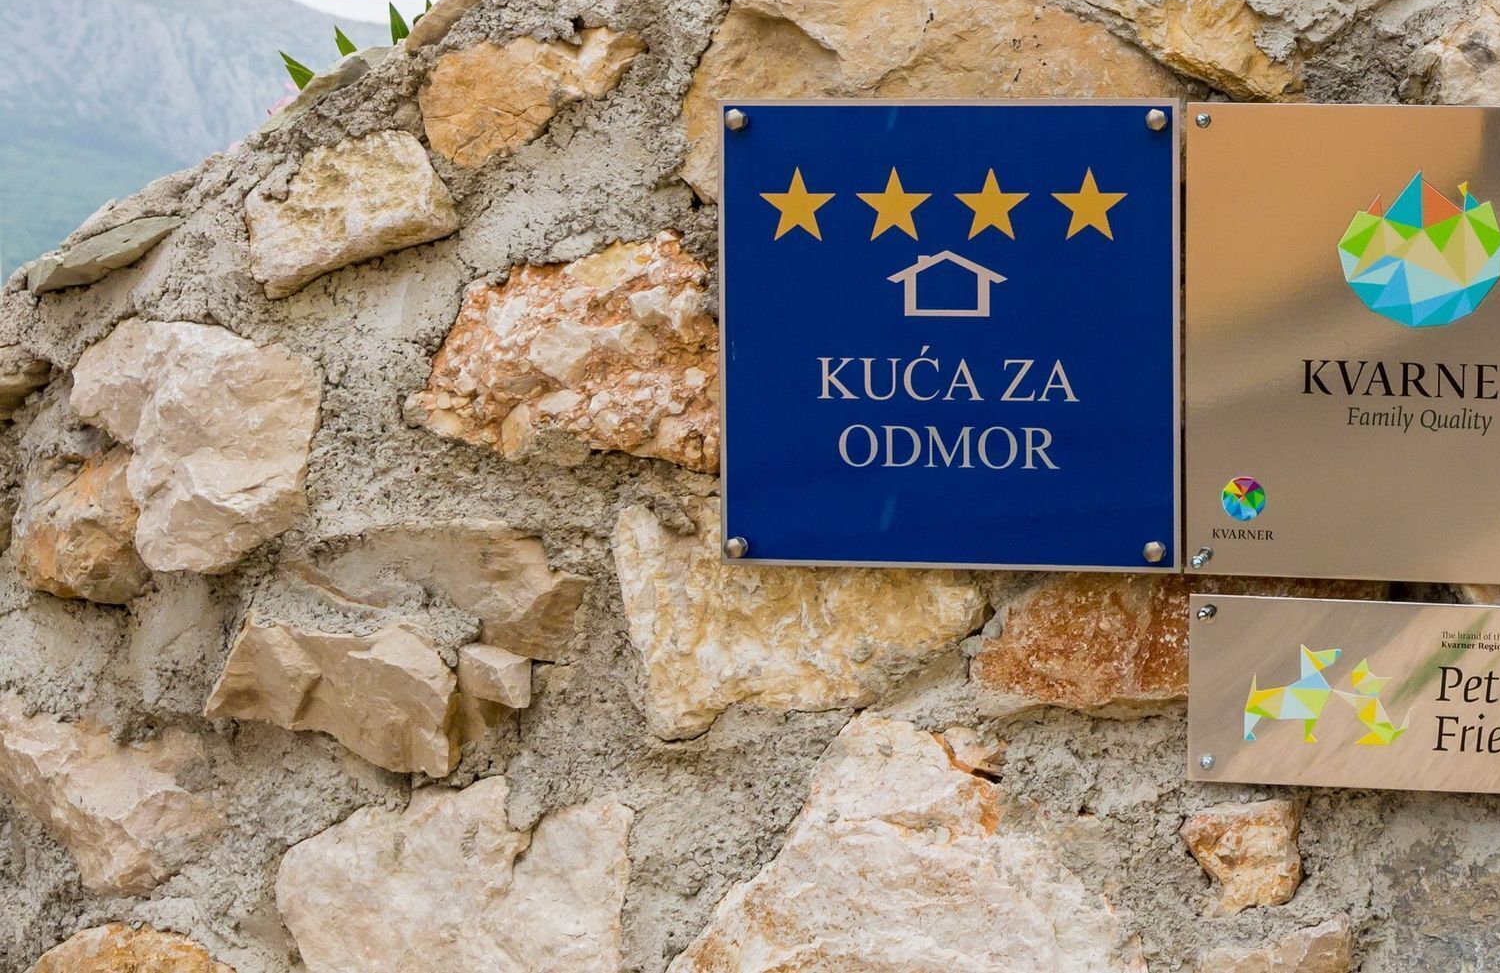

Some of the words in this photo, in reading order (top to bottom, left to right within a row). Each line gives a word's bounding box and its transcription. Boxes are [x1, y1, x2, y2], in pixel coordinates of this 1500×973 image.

[816, 345, 984, 401] KUĆA
[1000, 359, 1080, 402] ZA
[1346, 405, 1414, 433] Family
[1420, 408, 1493, 436] Quality
[838, 424, 1061, 469] ODMOR
[1212, 528, 1274, 541] KVARNER
[1441, 631, 1456, 640] The
[1458, 631, 1481, 640] brand
[1483, 632, 1492, 641] of
[1441, 641, 1476, 649] Kvarner
[1435, 666, 1500, 703] Pet
